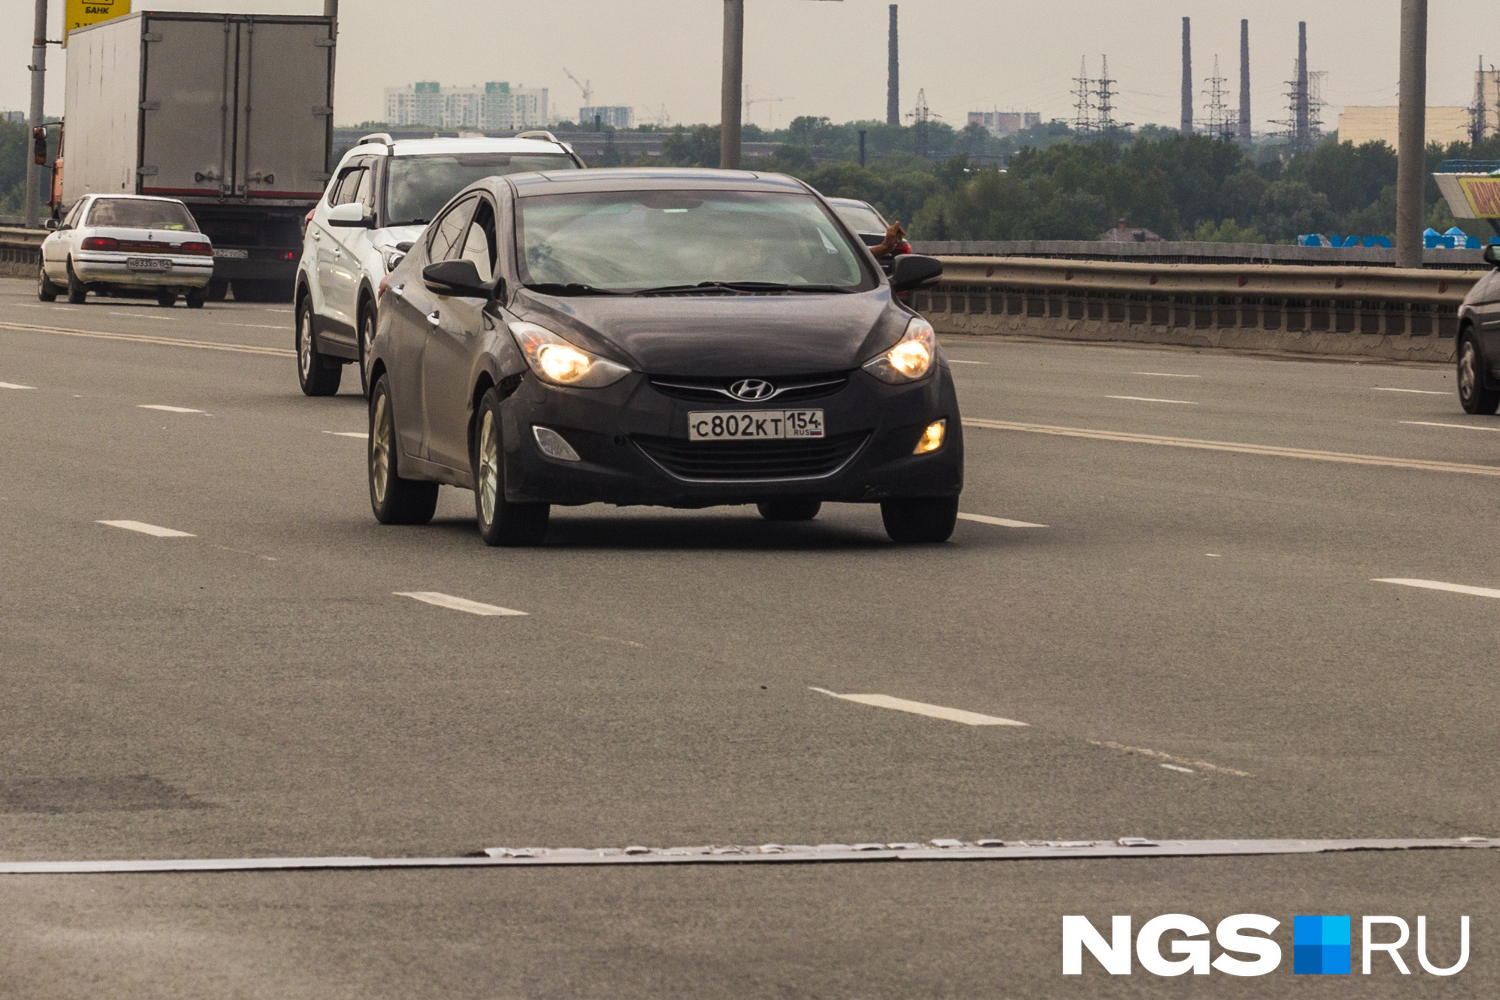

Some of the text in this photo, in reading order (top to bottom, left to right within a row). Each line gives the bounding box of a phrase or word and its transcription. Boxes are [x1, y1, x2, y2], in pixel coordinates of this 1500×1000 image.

[85, 6, 110, 14] БАНК
[696, 411, 820, 437] С802КТ 154
